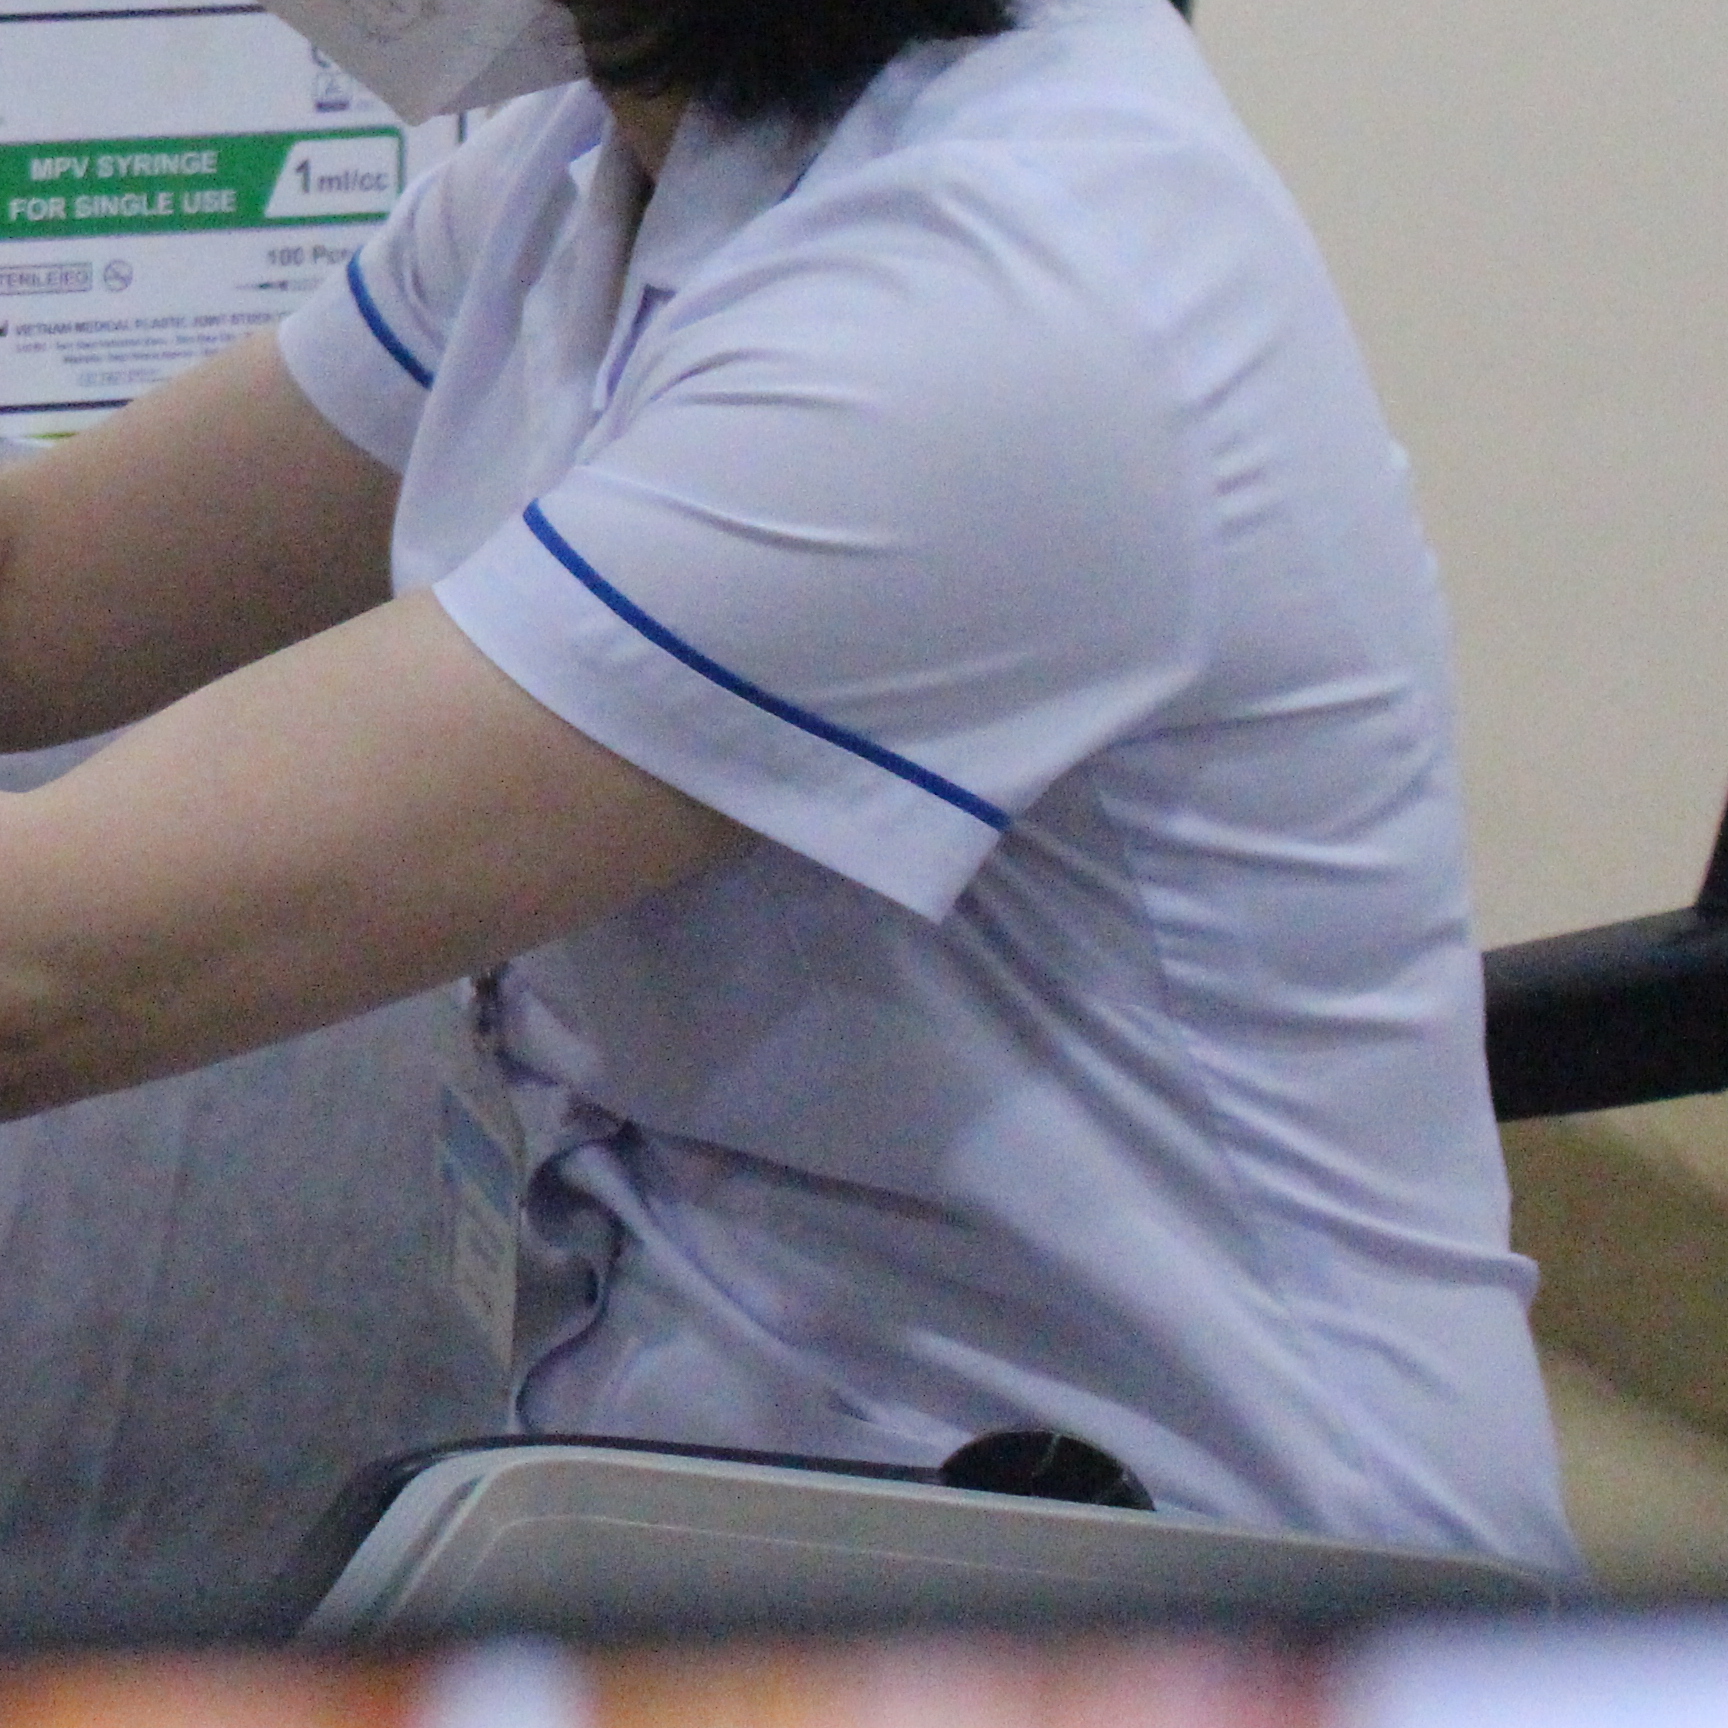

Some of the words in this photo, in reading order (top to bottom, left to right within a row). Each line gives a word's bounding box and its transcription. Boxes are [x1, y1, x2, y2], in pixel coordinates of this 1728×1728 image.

[30, 156, 91, 182] MPV
[97, 150, 219, 179] SYRINGE
[295, 158, 311, 193] 1
[8, 196, 66, 222] FOR
[74, 192, 174, 219] SINGLE
[183, 188, 237, 214] USE
[268, 245, 305, 267] 100
